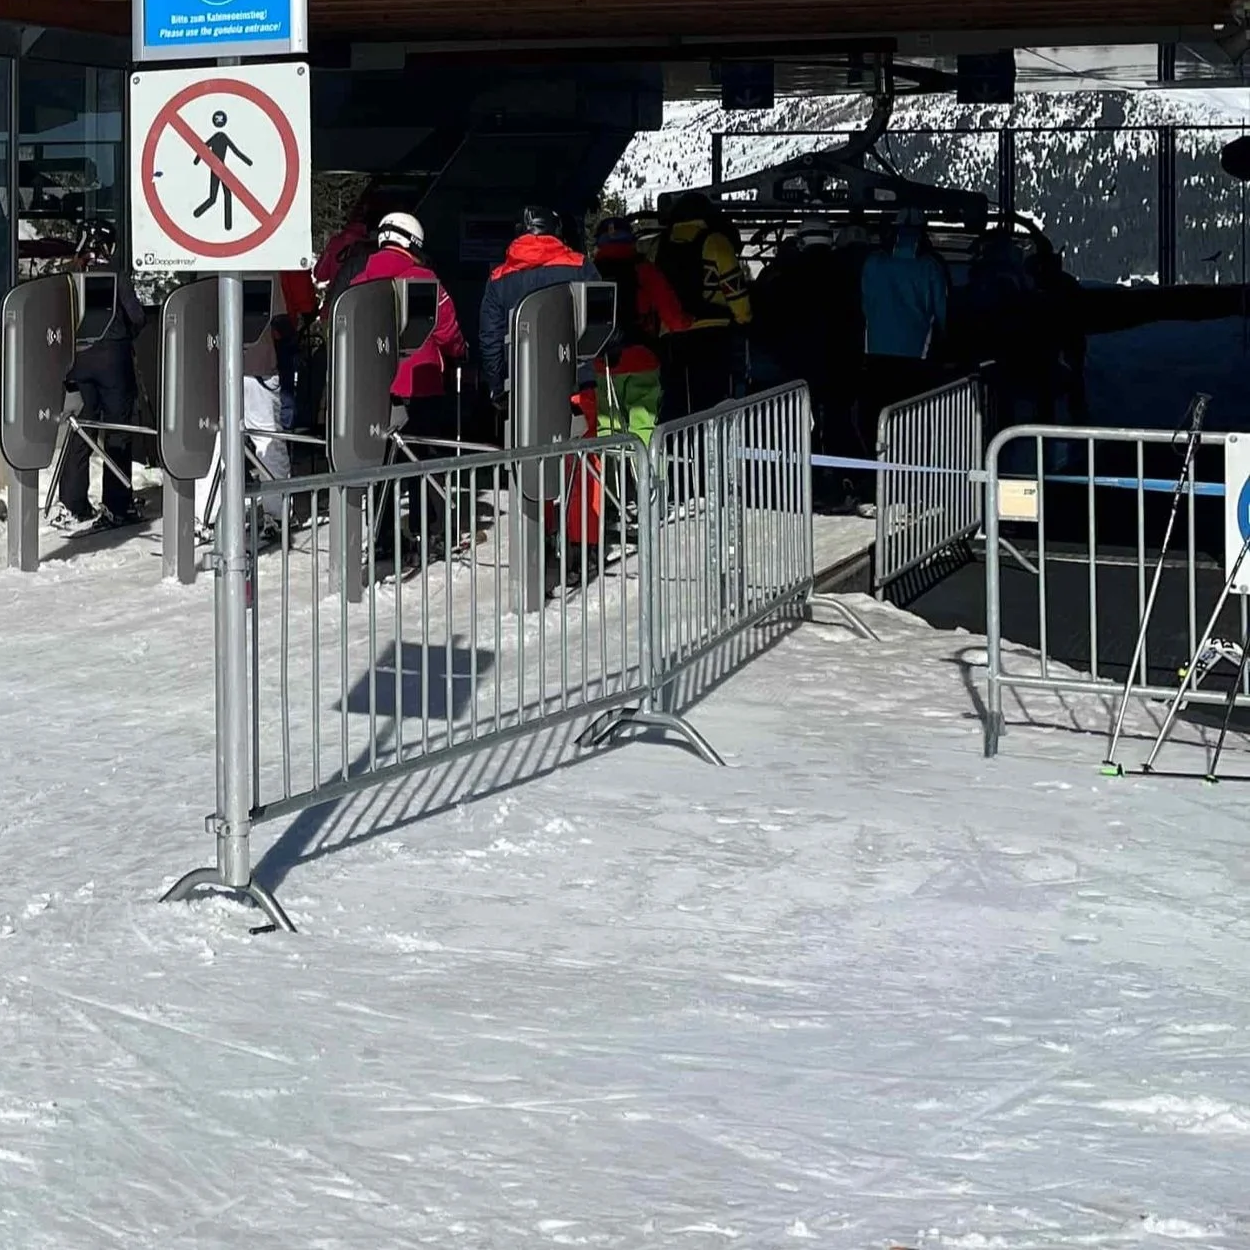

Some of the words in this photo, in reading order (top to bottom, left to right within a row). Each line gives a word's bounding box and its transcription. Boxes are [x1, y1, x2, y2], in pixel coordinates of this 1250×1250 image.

[171, 14, 189, 24] Bitte
[190, 15, 206, 24] zum
[159, 28, 184, 38] Please
[186, 29, 199, 37] use
[200, 27, 211, 36] the
[213, 24, 243, 37] gondola
[244, 21, 282, 34] entrance!
